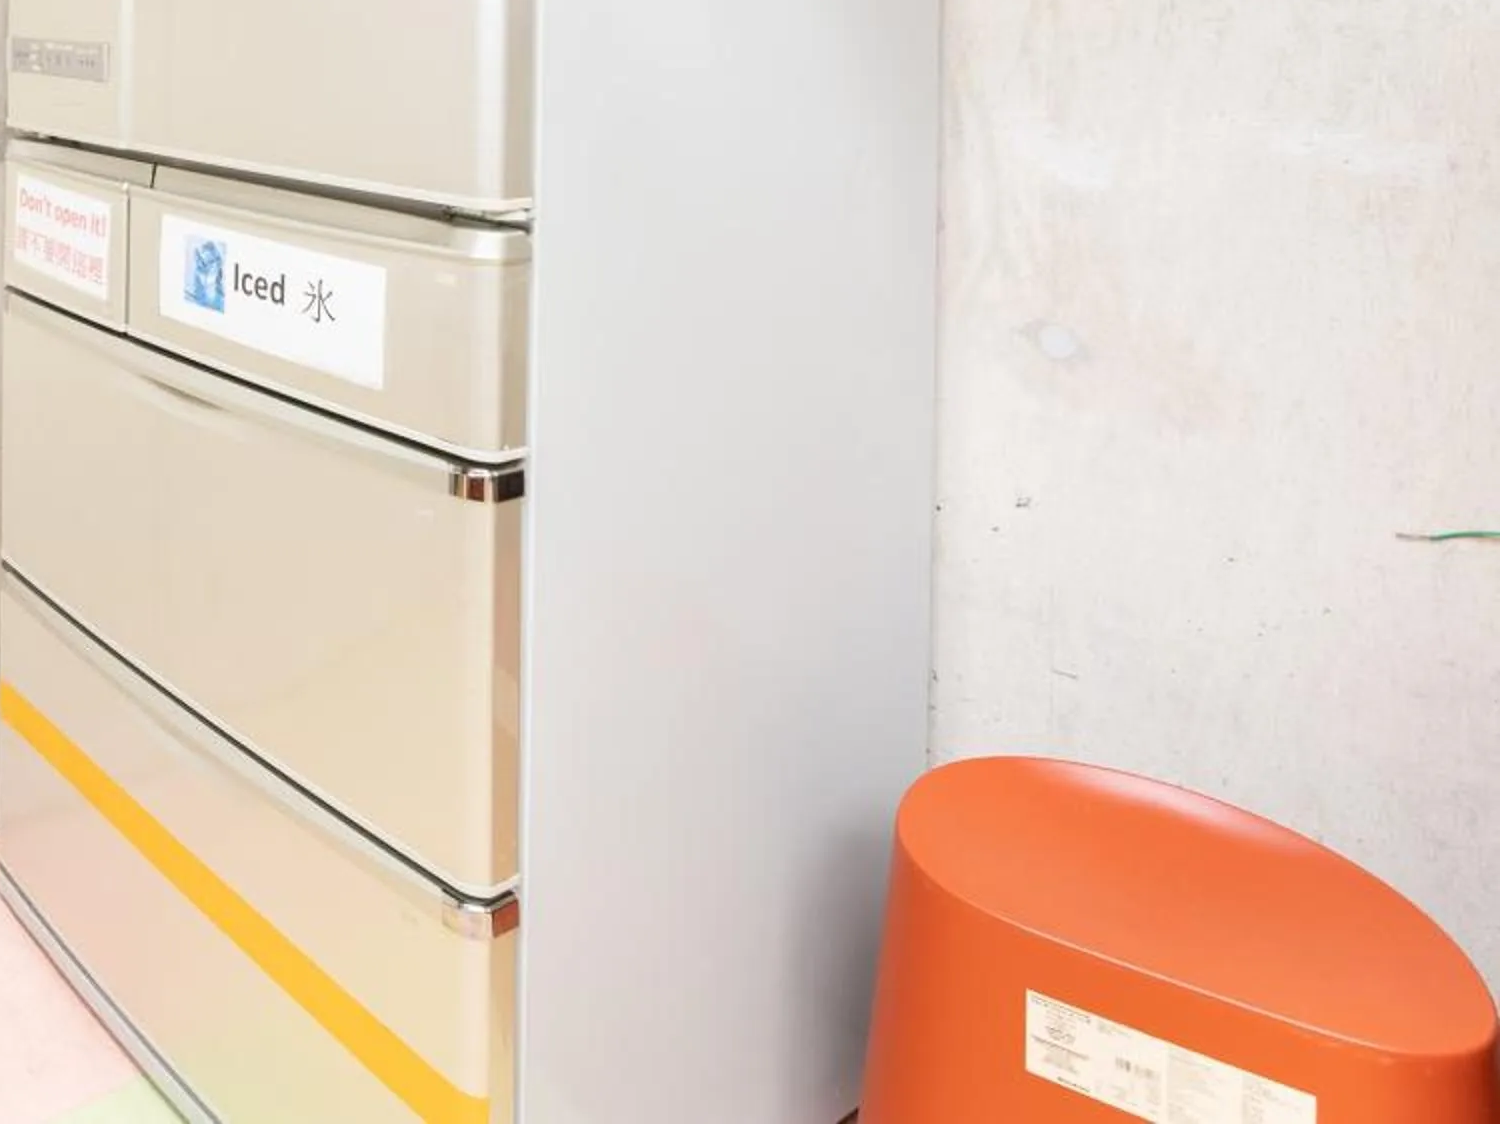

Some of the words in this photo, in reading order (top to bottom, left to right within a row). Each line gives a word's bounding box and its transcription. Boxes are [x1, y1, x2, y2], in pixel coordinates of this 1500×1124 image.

[20, 187, 52, 218] Don't
[54, 205, 87, 230] open
[233, 262, 286, 306] Iced
